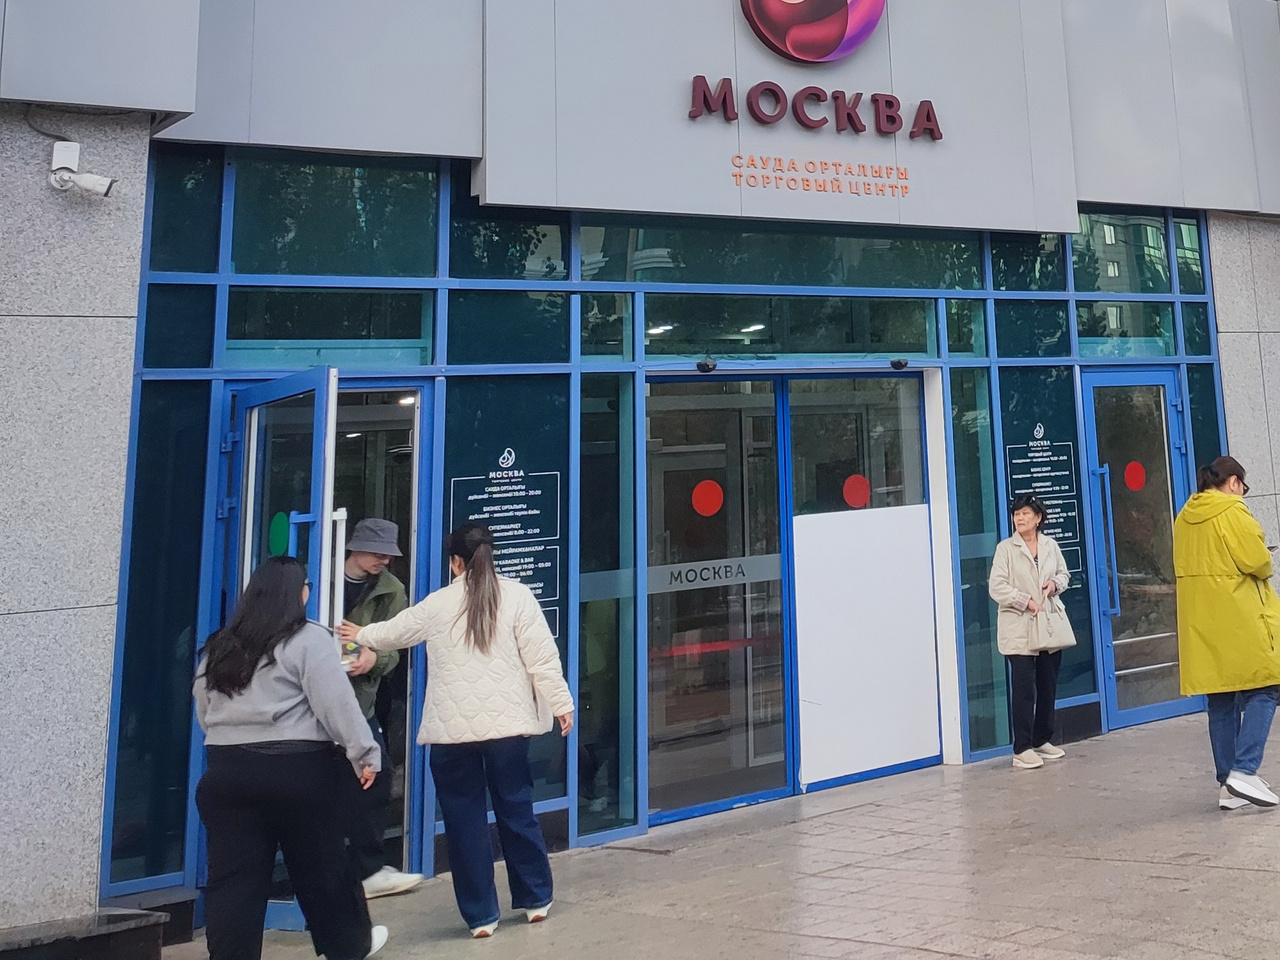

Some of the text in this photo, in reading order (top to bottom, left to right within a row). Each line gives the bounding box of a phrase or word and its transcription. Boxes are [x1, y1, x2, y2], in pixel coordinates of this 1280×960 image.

[688, 75, 943, 141] МОСКВА
[731, 153, 909, 181] САУДА ОРТАЛЫҒЫ
[731, 171, 910, 198] ТОРГОВЫЙ ЦЕНТР
[489, 469, 525, 479] МОСКВА
[668, 563, 746, 586] МОСКВА
